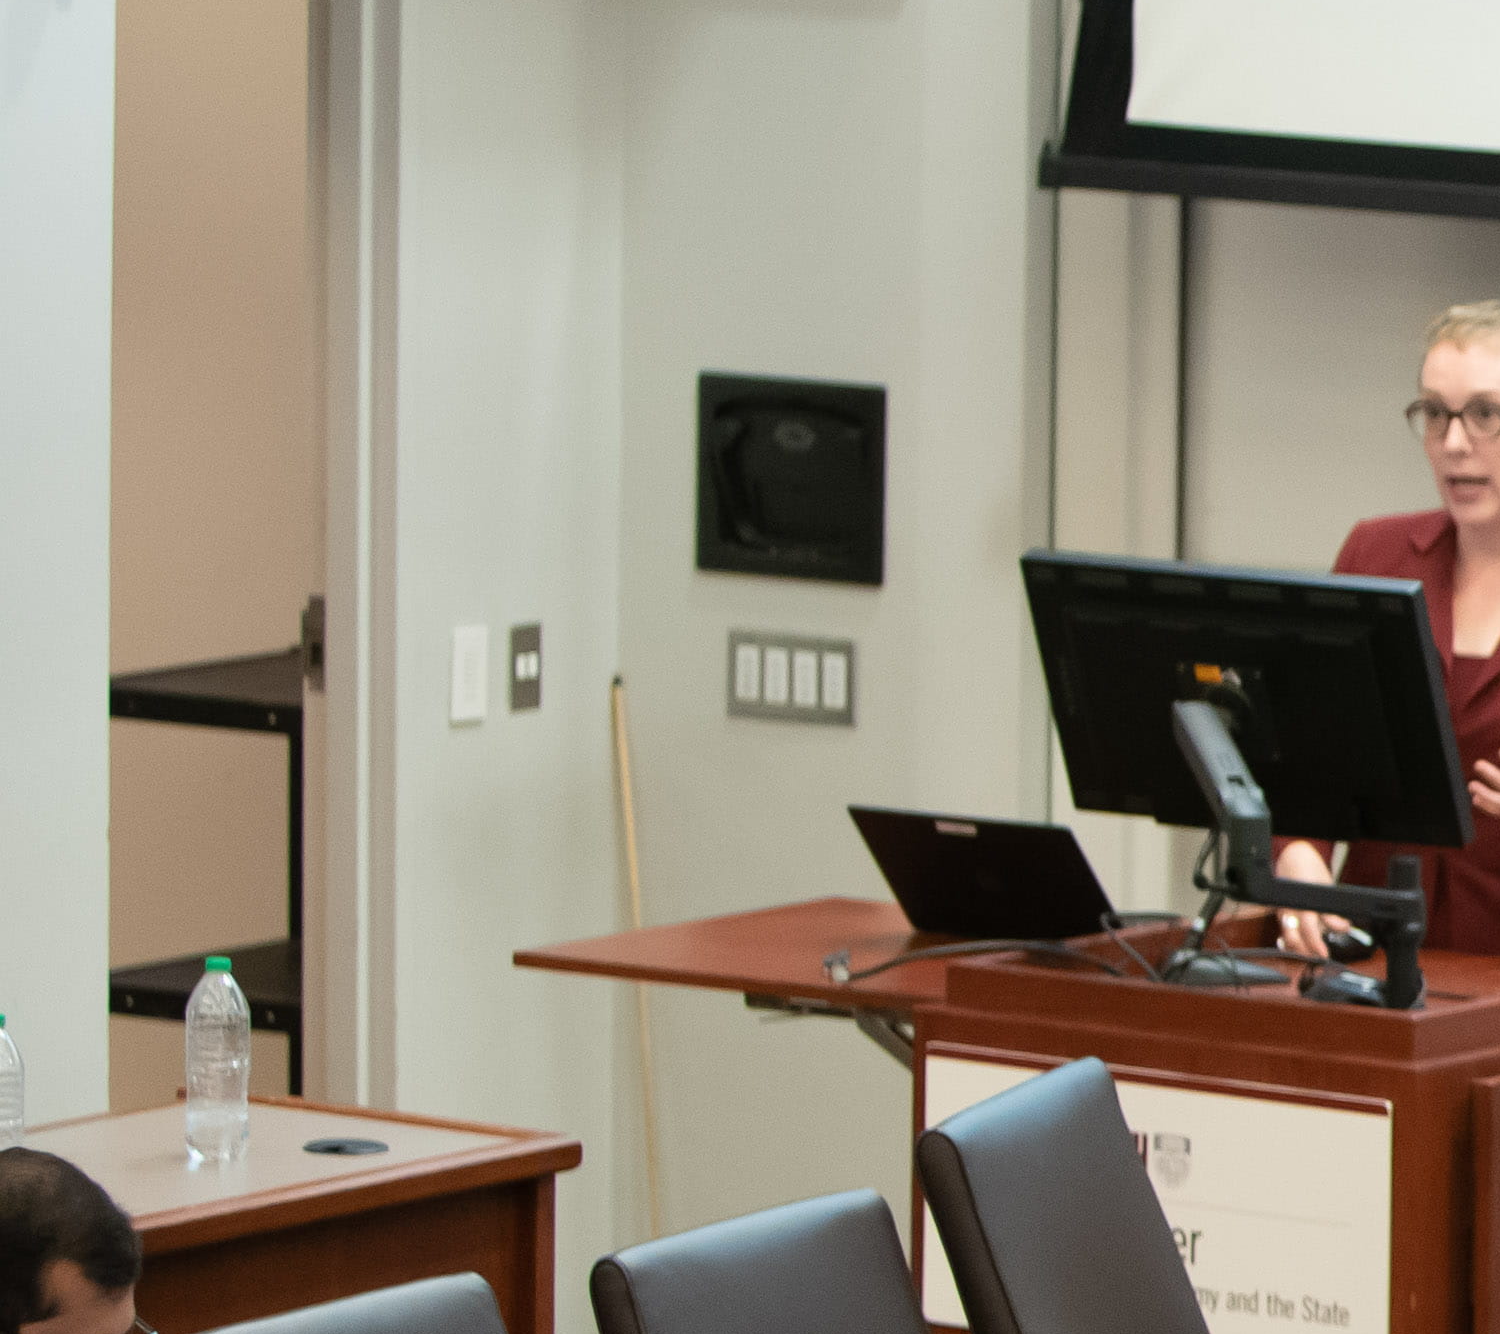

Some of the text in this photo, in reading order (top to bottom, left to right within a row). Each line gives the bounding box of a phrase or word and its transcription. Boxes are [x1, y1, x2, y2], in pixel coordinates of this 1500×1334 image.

[1225, 1289, 1259, 1315] and
[1266, 1292, 1294, 1319] the
[1302, 1294, 1350, 1326] State
